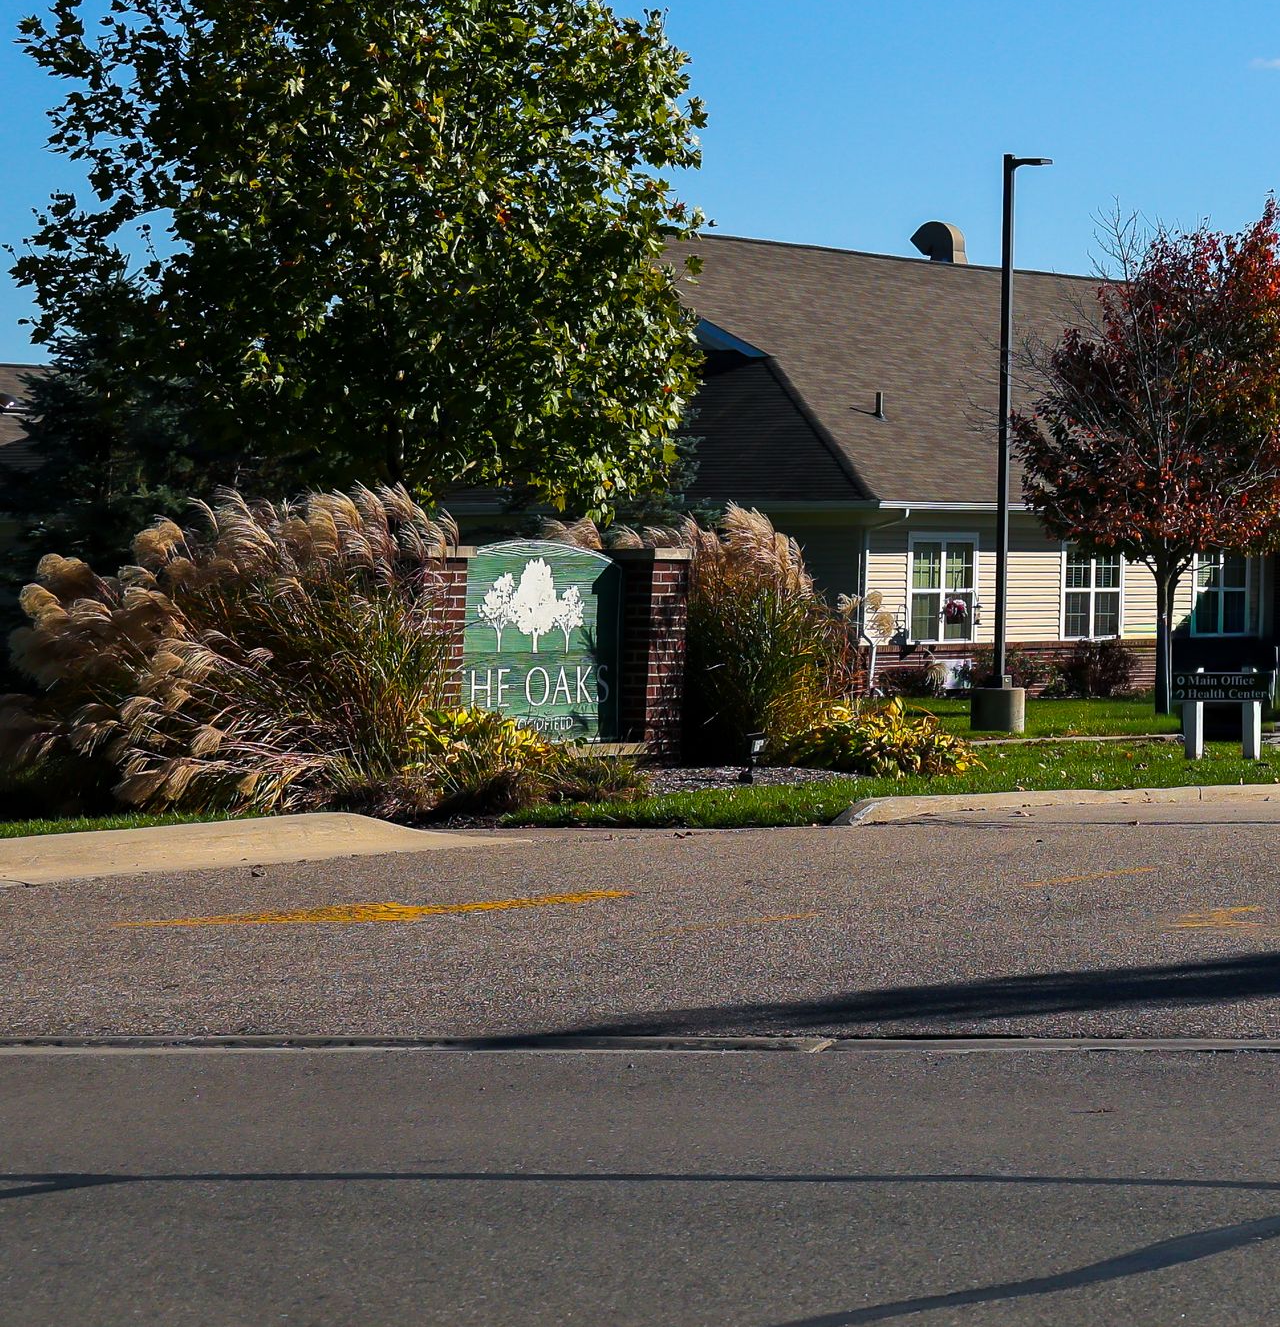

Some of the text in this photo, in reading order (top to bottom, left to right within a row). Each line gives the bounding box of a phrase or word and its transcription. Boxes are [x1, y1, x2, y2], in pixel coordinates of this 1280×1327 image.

[1188, 675, 1255, 685] Main Office
[463, 664, 610, 708] HE OAKS
[1188, 689, 1267, 698] Health Center
